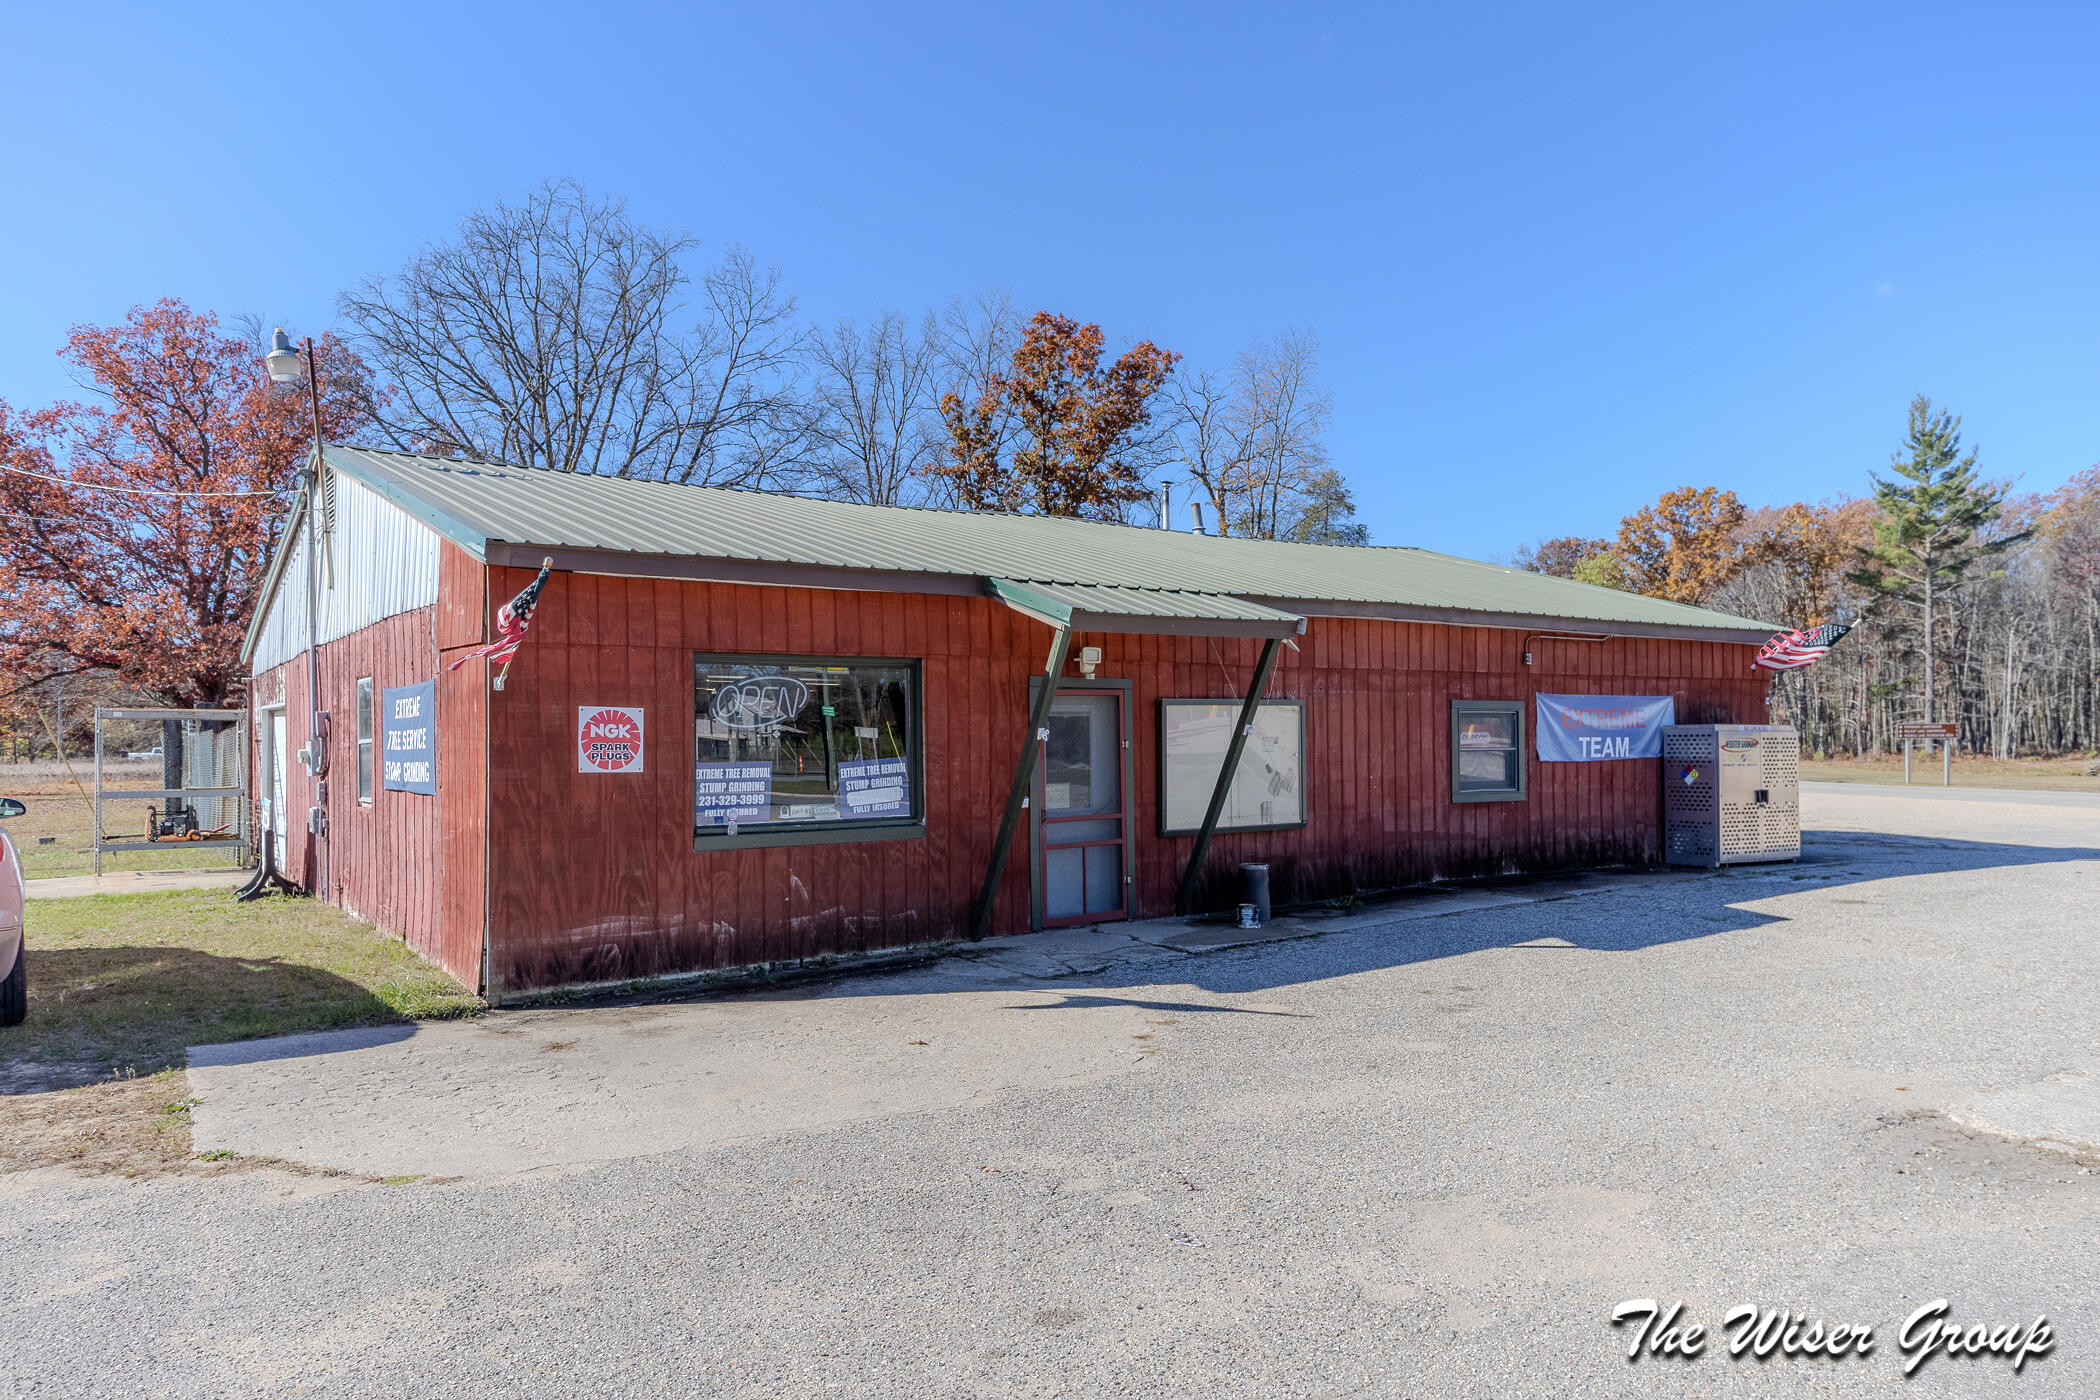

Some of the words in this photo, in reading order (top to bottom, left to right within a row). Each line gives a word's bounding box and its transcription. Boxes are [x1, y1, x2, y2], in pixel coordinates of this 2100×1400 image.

[395, 696, 420, 719] EXTREME
[717, 685, 800, 718] OPEN
[1561, 708, 1646, 729] EXTREME
[590, 723, 631, 738] NGK
[402, 728, 427, 750] SERVICE
[591, 743, 630, 751] SPARK
[1578, 736, 1630, 758] TEAM
[404, 762, 429, 783] GRINDING
[696, 768, 724, 779] EXTREME
[725, 768, 741, 779] TREE
[742, 767, 771, 778] REMOVAL
[840, 766, 866, 779] EXTREME
[866, 764, 880, 776] TREE
[880, 762, 906, 775] REMOVAL
[700, 782, 727, 793] STUMP
[728, 781, 765, 792] GRINDING
[845, 779, 869, 791] STUMP
[871, 776, 903, 788] GRINDING
[698, 794, 765, 806] 231-329-3999
[853, 804, 871, 814] FULLY
[872, 801, 900, 812] INSURED
[704, 808, 725, 817] FULLY
